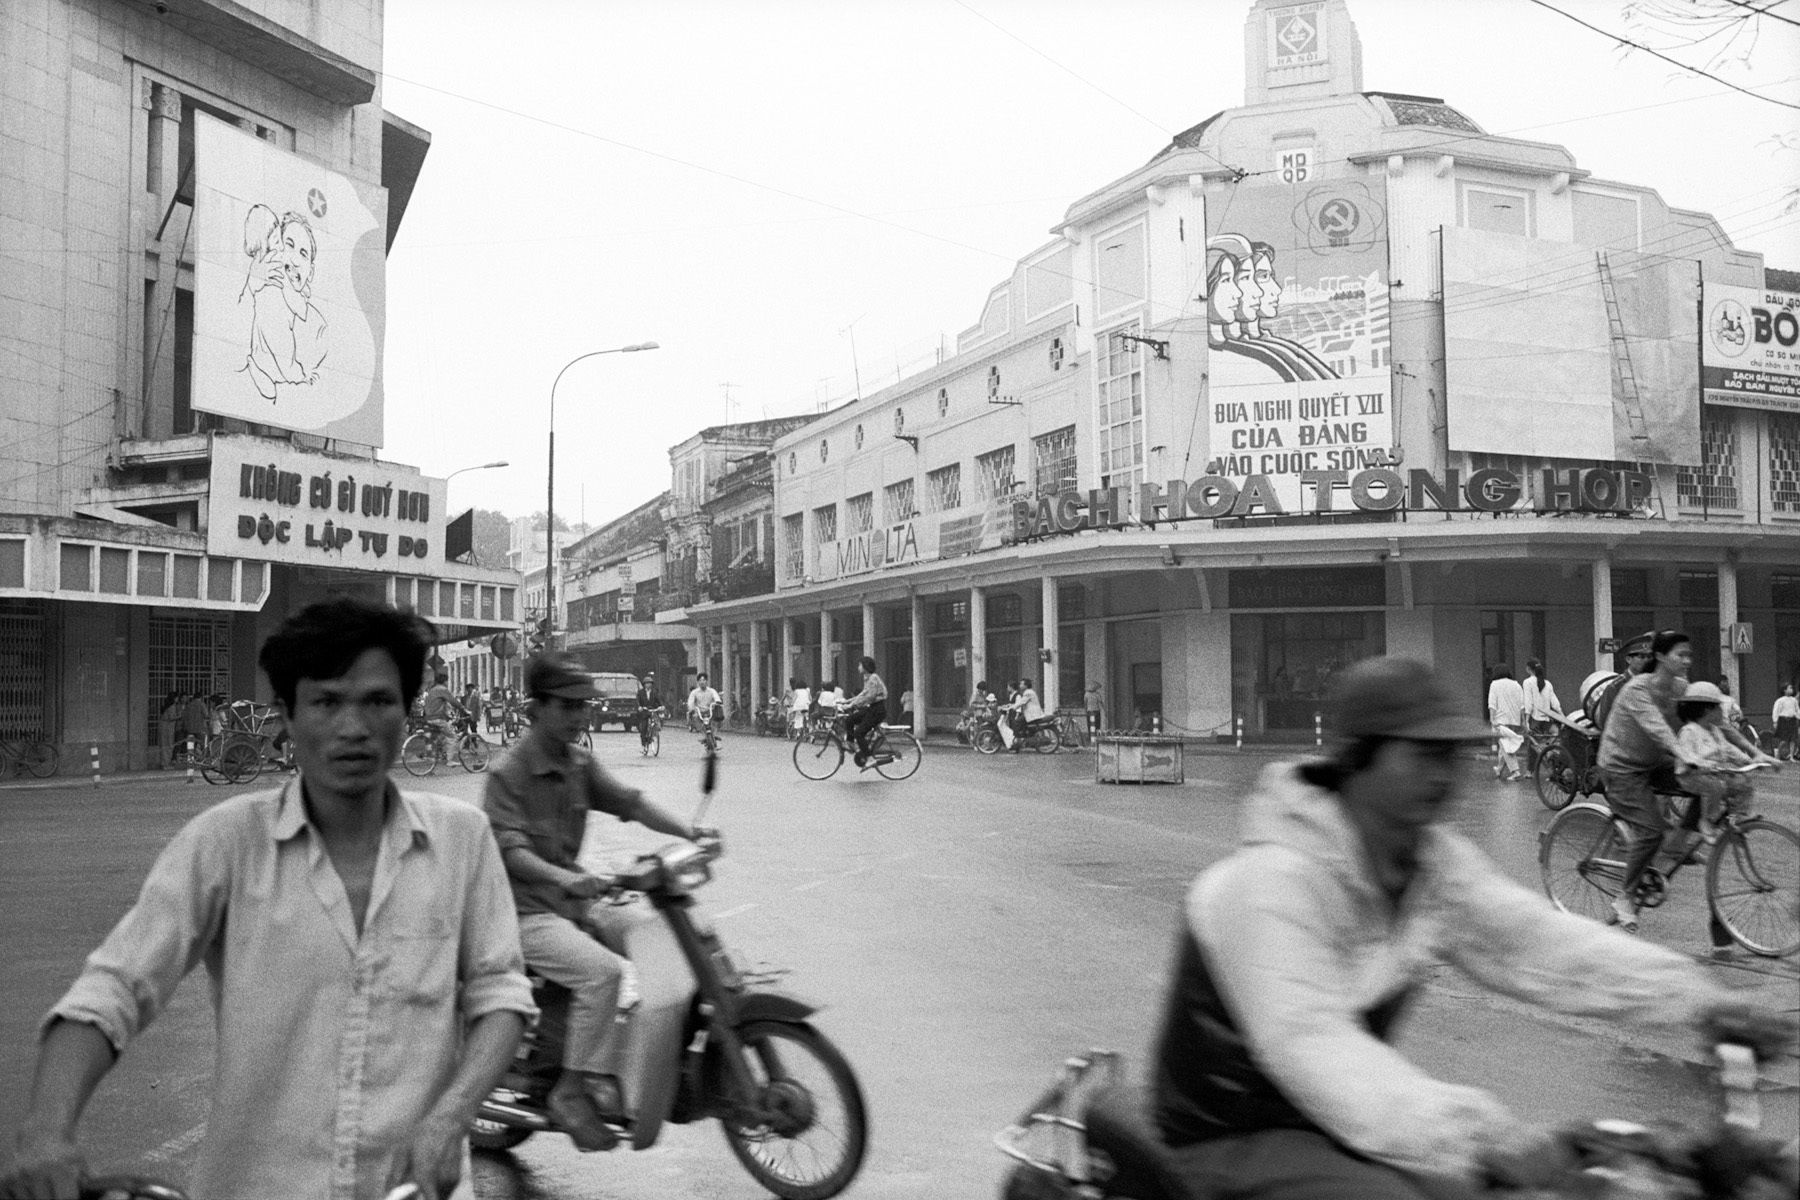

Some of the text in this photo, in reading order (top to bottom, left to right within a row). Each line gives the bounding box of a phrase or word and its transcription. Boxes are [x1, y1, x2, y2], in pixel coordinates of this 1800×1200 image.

[1215, 391, 1384, 424] ĐƯA NGHỊ QUYẾT VII
[1231, 419, 1367, 450] CỦA ĐẢNG
[1261, 449, 1318, 477] CUỘC
[310, 470, 332, 509] CÓ
[305, 518, 353, 552] LẬP
[398, 534, 429, 559] DO
[836, 521, 919, 576] MINOLTA
